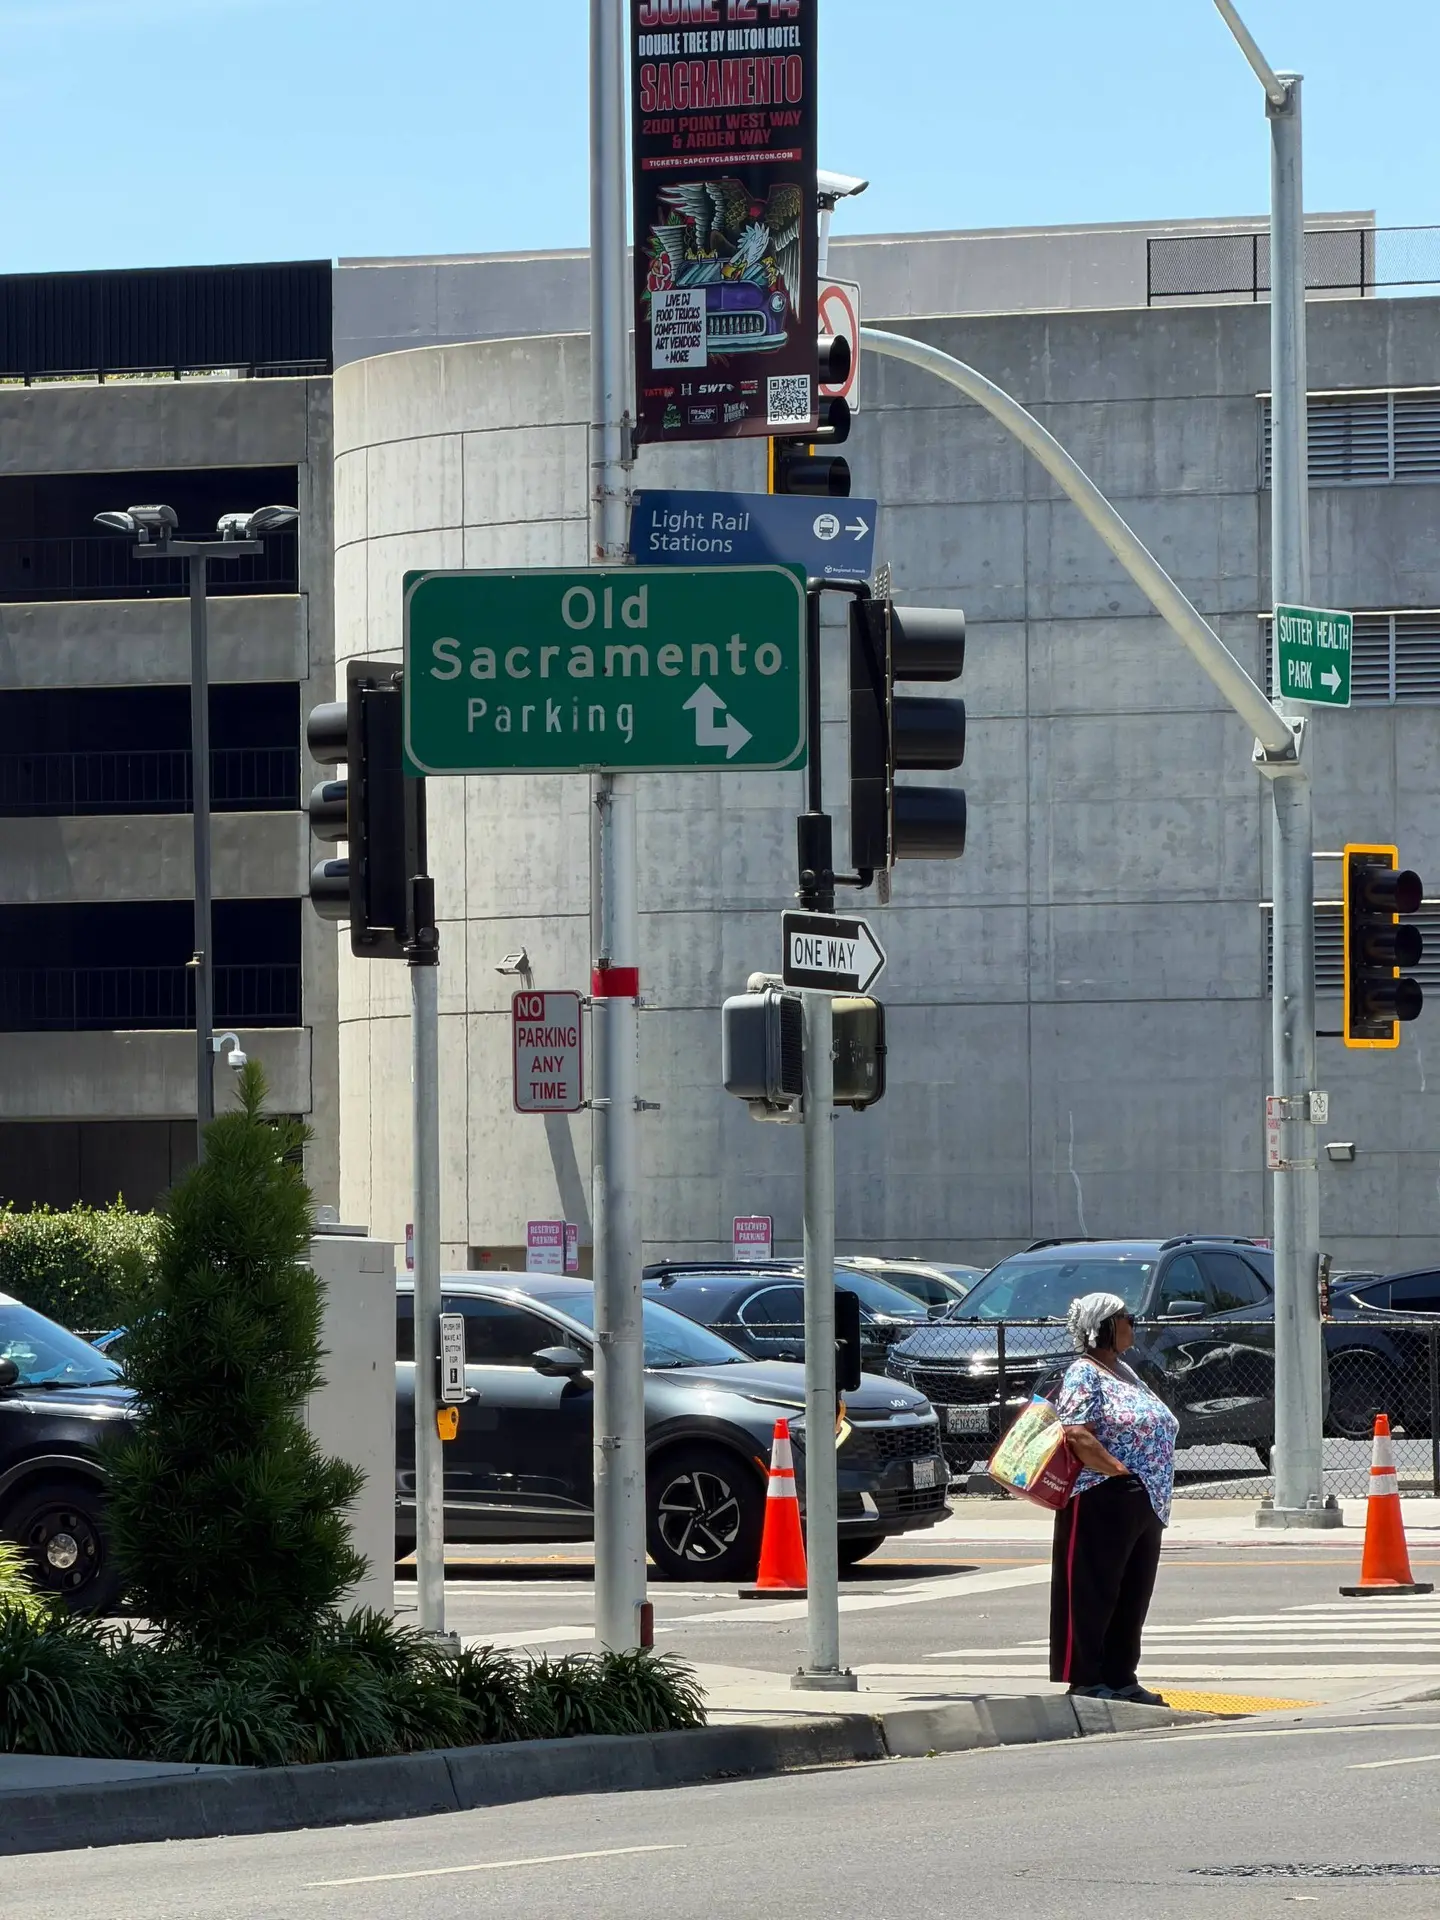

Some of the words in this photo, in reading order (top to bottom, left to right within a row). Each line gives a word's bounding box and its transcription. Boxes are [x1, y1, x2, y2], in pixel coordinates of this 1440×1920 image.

[638, 33, 681, 56] DOUBLE
[683, 31, 709, 54] TREE
[711, 30, 725, 52] BY
[727, 28, 766, 51] HILTON
[767, 26, 801, 49] HOTEL
[640, 55, 803, 112] SACRAMENTO
[642, 118, 675, 134] 2001
[679, 115, 722, 132] POINT
[725, 112, 766, 130] WEST
[769, 110, 802, 127] WAY
[686, 130, 735, 149] ARDEN
[740, 128, 771, 145] WAY
[649, 159, 682, 167] TICKETS:
[665, 293, 681, 307] LIVE
[681, 292, 691, 306] DJ
[656, 308, 674, 322] FOOD
[675, 306, 700, 320] TRUCKS
[654, 321, 702, 336] COMPETITIONS
[655, 337, 669, 350] ART
[670, 335, 701, 349] VENDORS
[669, 350, 689, 363] MORE
[681, 383, 692, 396] H
[698, 383, 726, 394] SWT
[651, 510, 704, 533] Light
[712, 512, 750, 531] Rail
[649, 532, 733, 553] Stations
[561, 584, 648, 630] Old
[1280, 616, 1313, 646] SUTTER
[1316, 621, 1349, 650] HEALTH
[430, 633, 782, 681] Sacramento
[1288, 659, 1313, 690] PARK
[467, 695, 634, 743] Parking
[794, 936, 822, 967] ONE
[827, 940, 856, 970] WAY
[517, 996, 543, 1017] NO
[518, 1027, 577, 1048] PARKING
[531, 1055, 564, 1073] ANY
[530, 1082, 567, 1099] TIME
[530, 1226, 559, 1234] RESERVED
[737, 1222, 767, 1231] RESERVED
[739, 1232, 765, 1241] PARKING
[532, 1236, 558, 1244] PARKING
